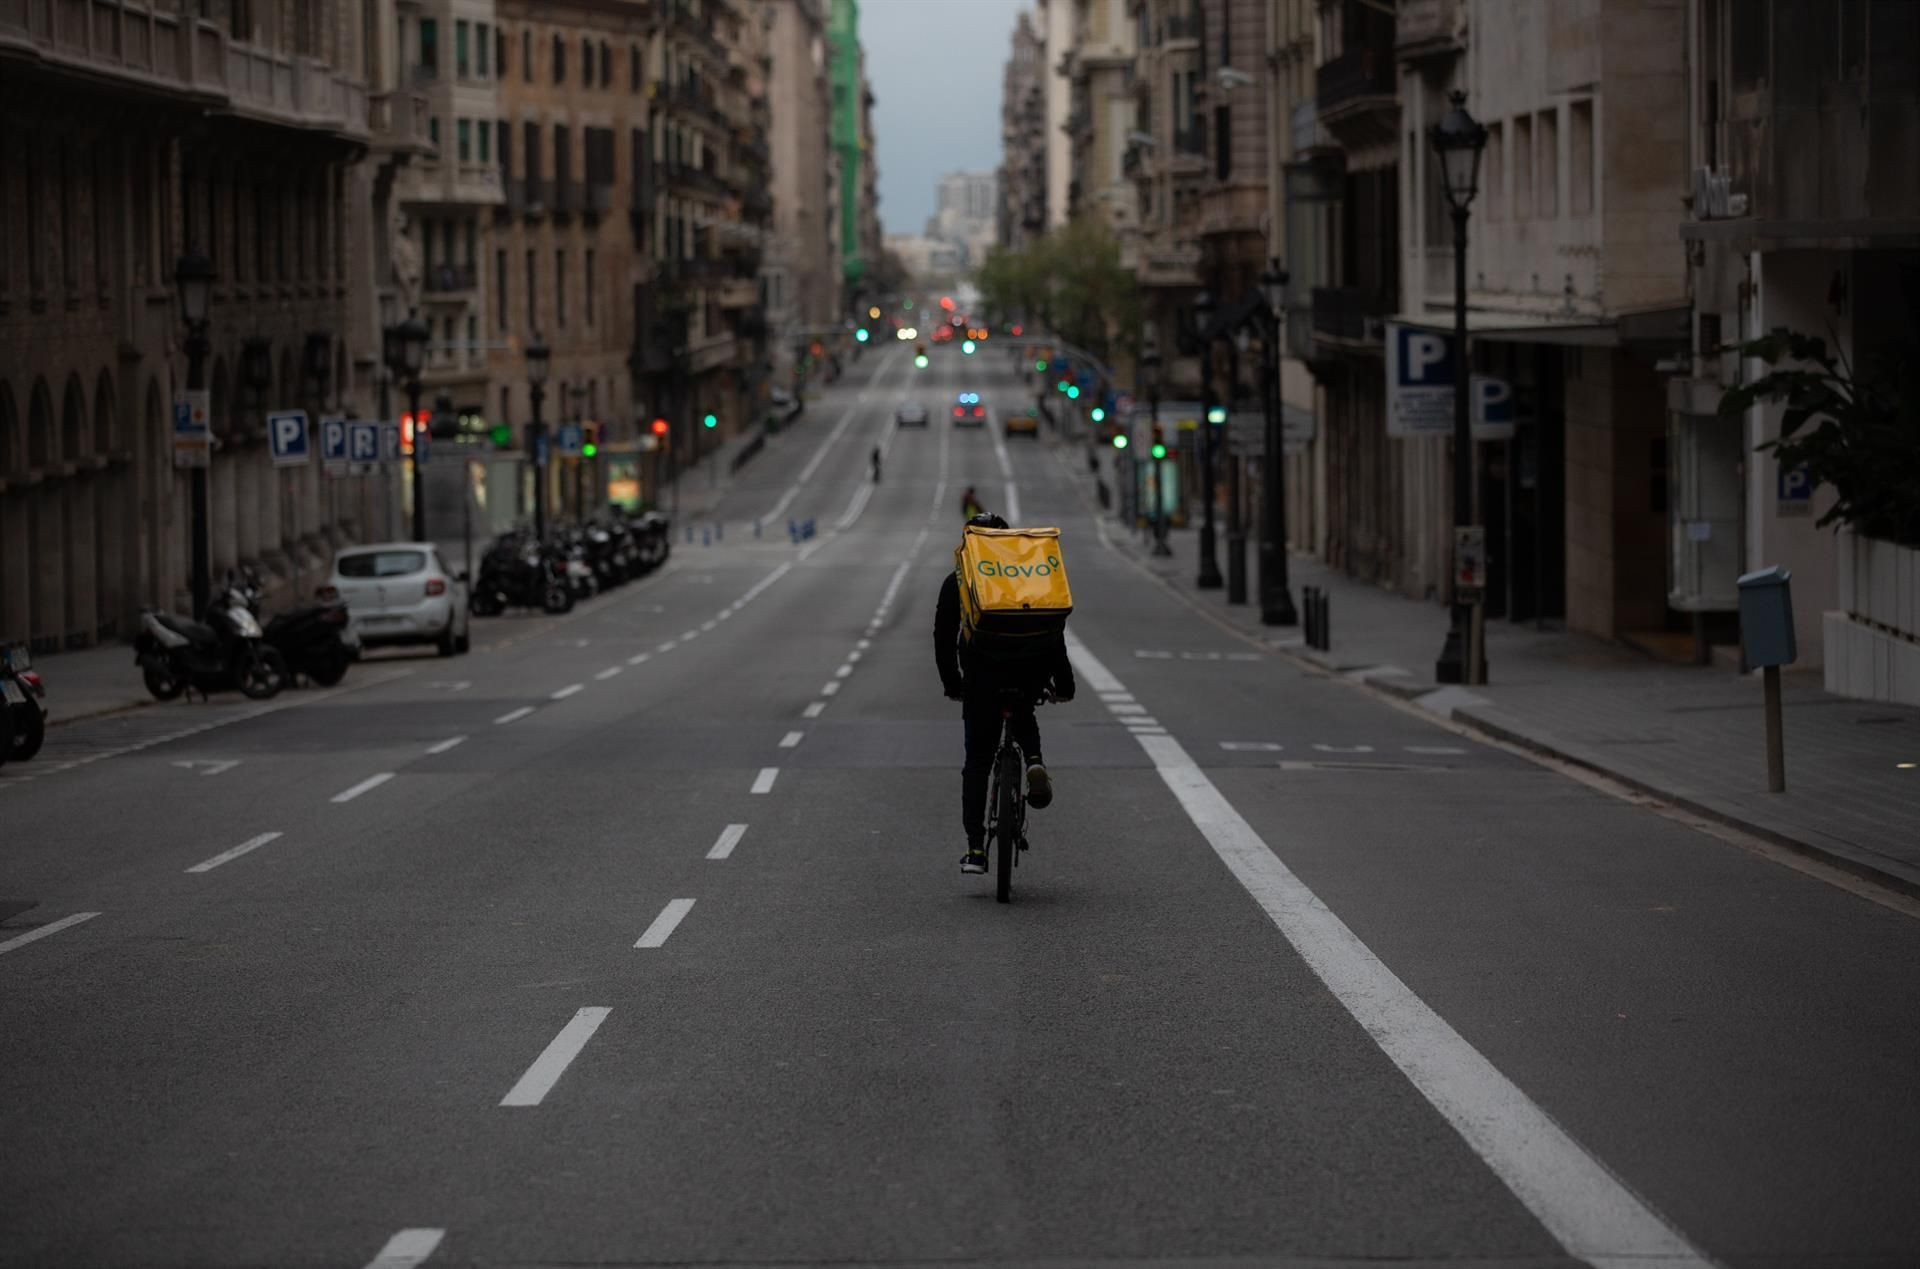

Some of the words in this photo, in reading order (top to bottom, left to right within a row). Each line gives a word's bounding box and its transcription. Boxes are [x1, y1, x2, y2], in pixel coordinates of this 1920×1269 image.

[1408, 333, 1446, 381] P
[1476, 379, 1511, 422] P
[275, 418, 301, 454] P
[327, 423, 343, 457] P
[1784, 470, 1805, 497] P
[977, 560, 1051, 578] Glovo
